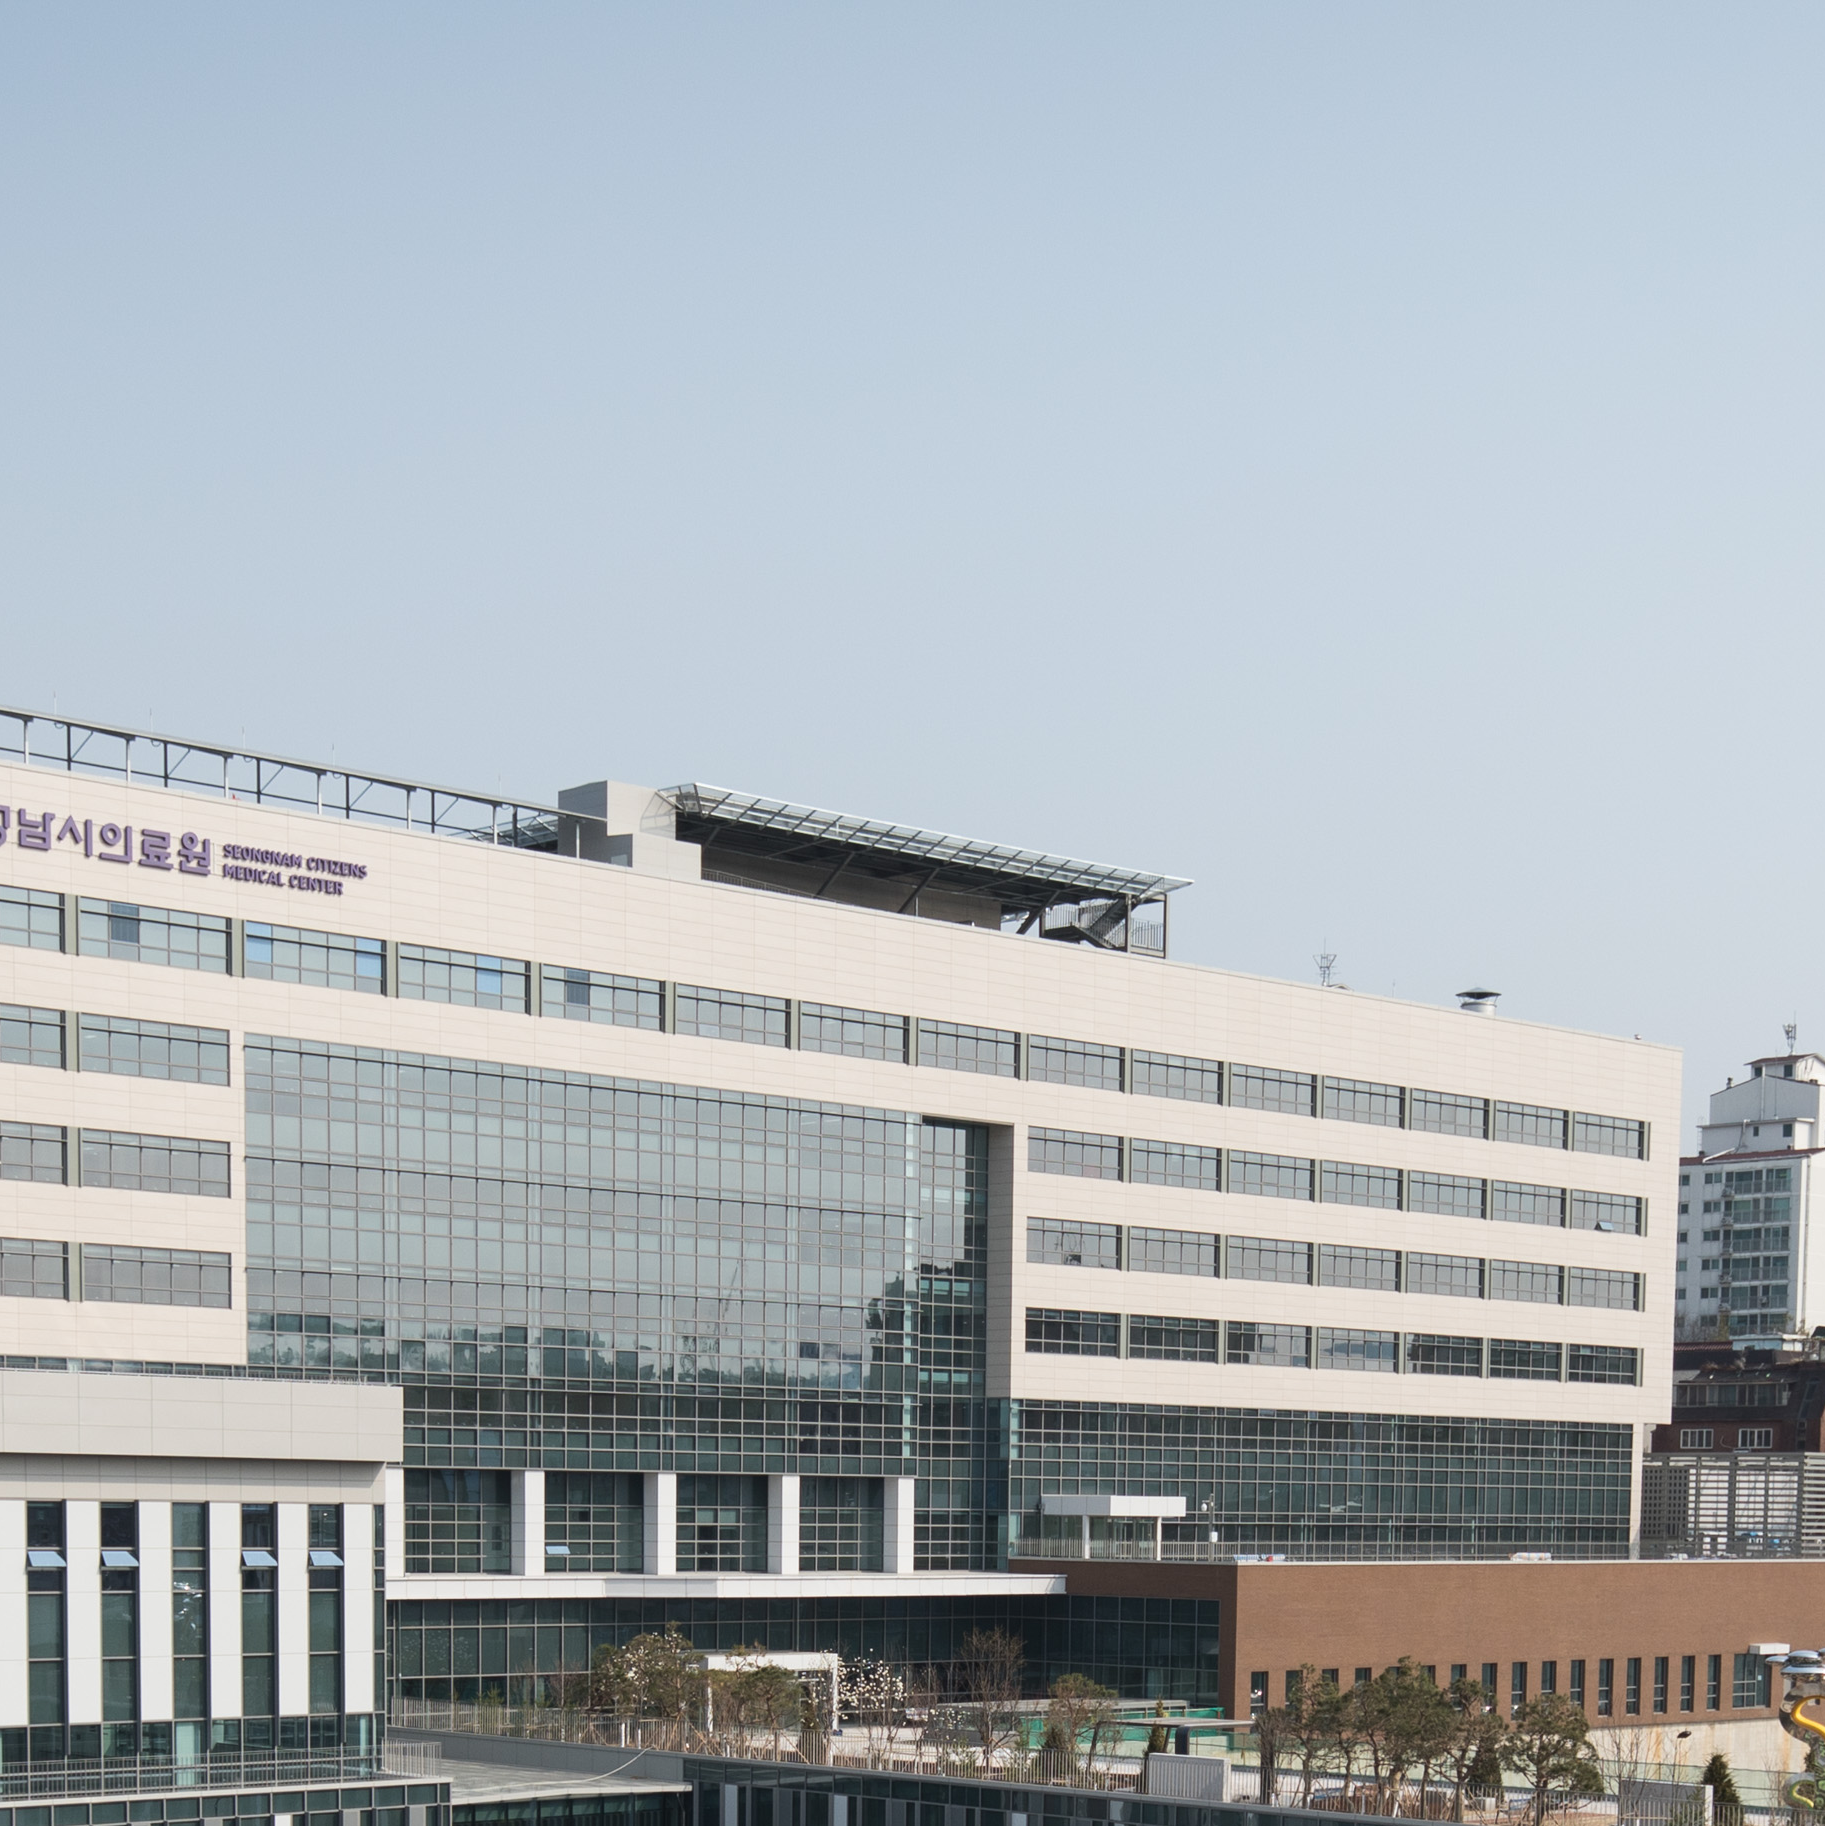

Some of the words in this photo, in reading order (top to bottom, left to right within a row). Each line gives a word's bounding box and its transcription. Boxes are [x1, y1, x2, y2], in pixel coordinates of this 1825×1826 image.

[222, 843, 304, 870] SEONGNAM
[306, 856, 369, 880] CITIZENS
[222, 863, 284, 887] MEDICAL
[287, 874, 345, 897] CENTER
